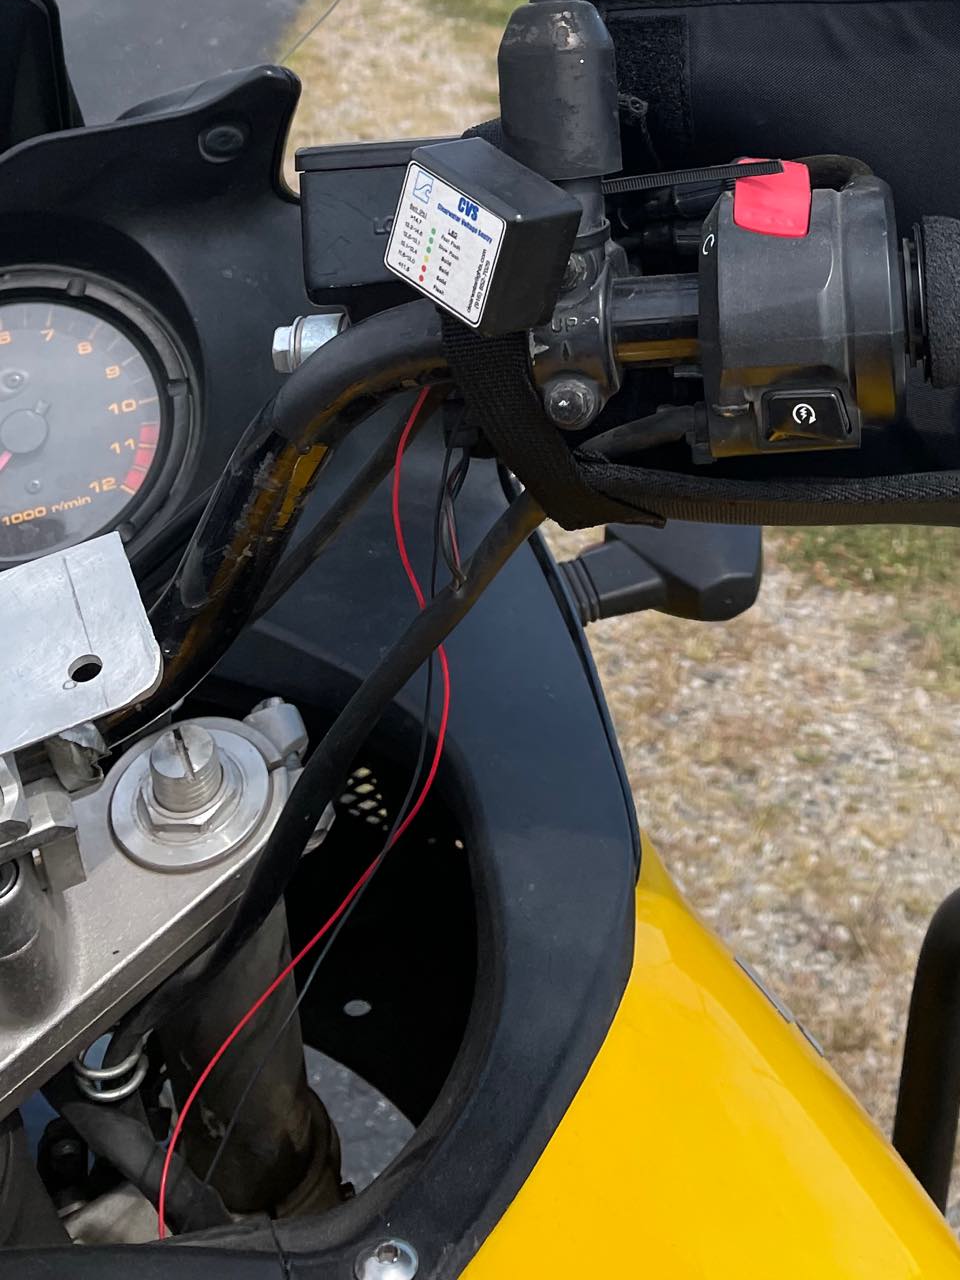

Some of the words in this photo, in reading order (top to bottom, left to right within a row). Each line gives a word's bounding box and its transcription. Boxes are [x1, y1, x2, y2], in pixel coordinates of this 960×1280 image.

[458, 197, 479, 221] CVS
[437, 202, 461, 222] Clearwater
[460, 218, 477, 233] Voltage
[477, 229, 492, 244] Sentry
[41, 330, 55, 342] 7
[78, 342, 92, 355] 8
[105, 367, 121, 378] 9
[107, 400, 137, 414] 10
[110, 439, 136, 454] 11
[89, 477, 118, 494] 12
[1, 506, 47, 526] 1000
[51, 496, 92, 512] r/min
